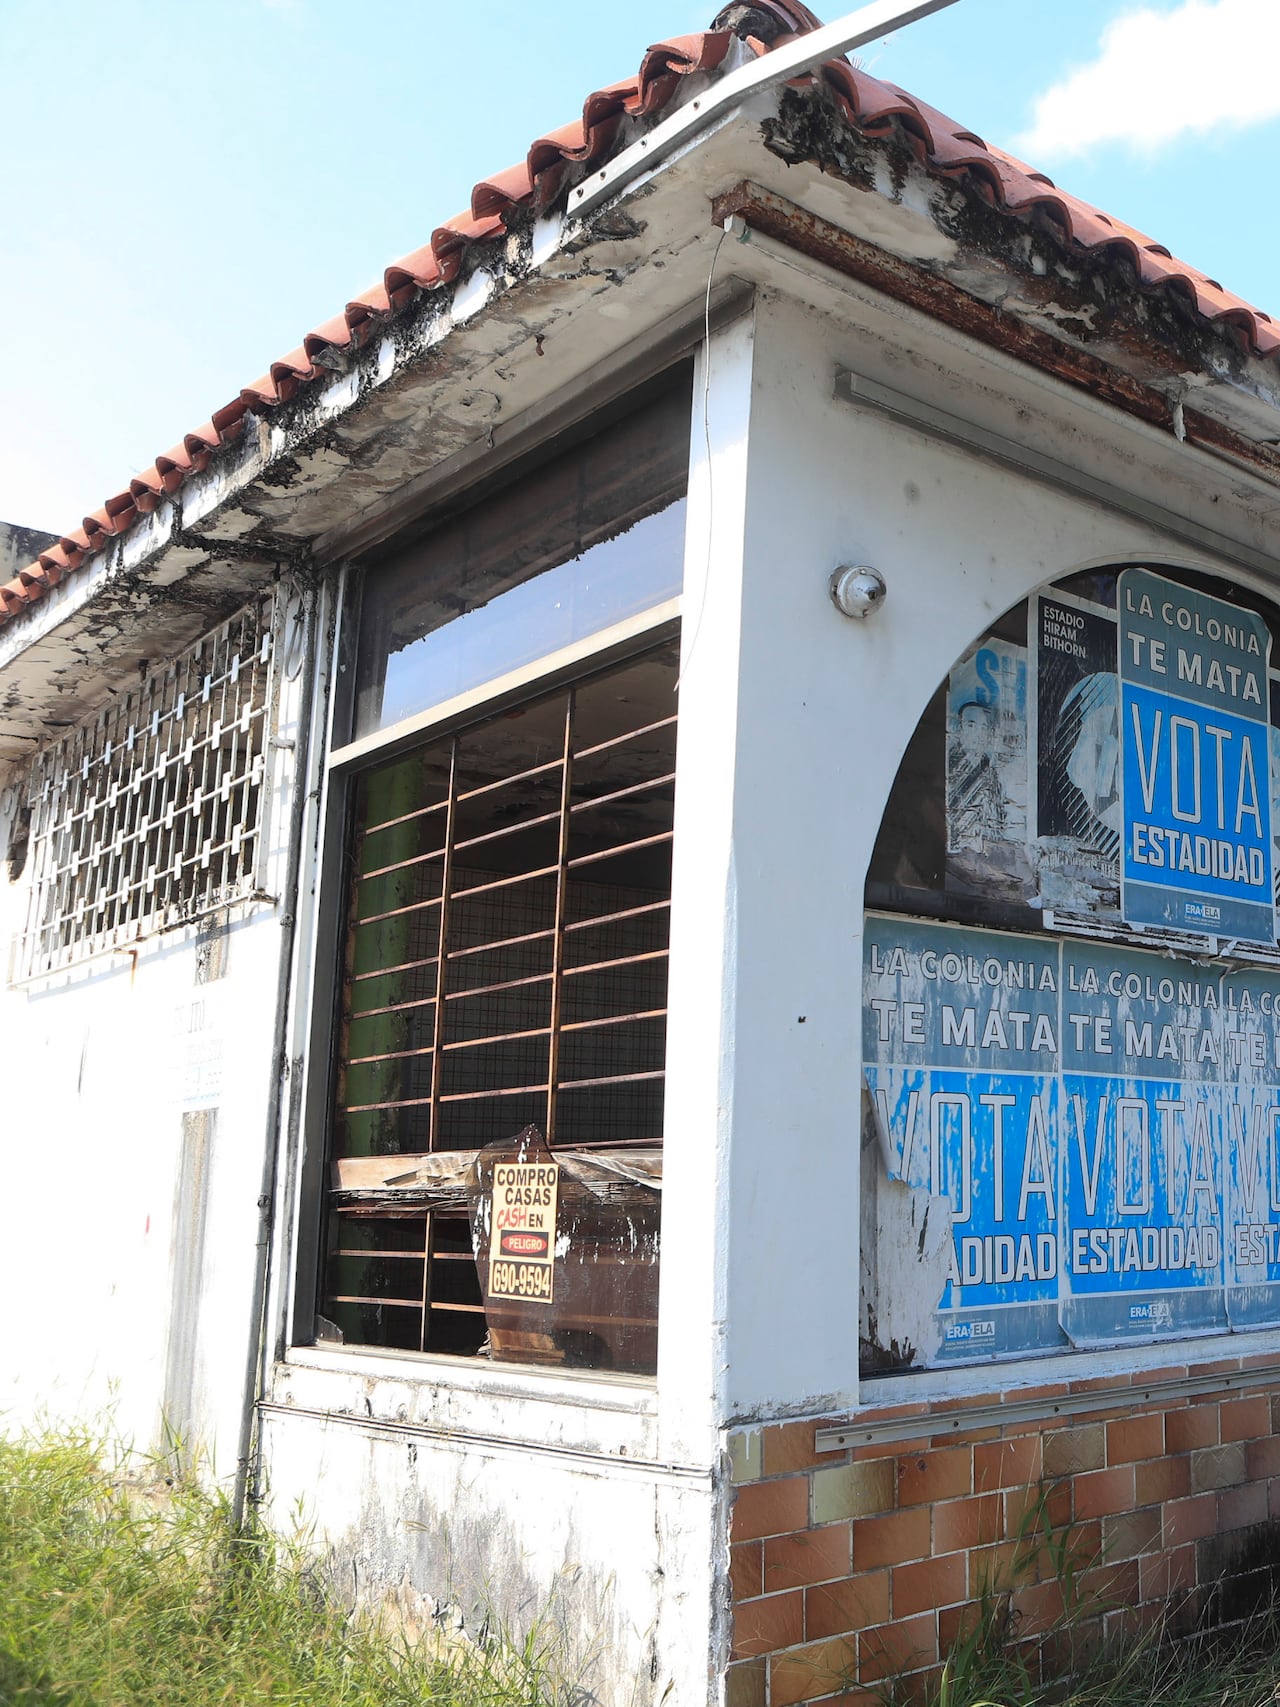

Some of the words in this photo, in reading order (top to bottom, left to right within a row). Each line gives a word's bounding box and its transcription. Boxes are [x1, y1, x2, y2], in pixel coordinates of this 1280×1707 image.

[1043, 605, 1085, 630] ESTADIO
[1043, 620, 1078, 642] HIRAM
[1126, 588, 1154, 619] LA
[1161, 602, 1261, 657] COLONIA
[1043, 633, 1086, 659] BITHORN
[1127, 630, 1168, 675] TE
[1177, 647, 1263, 706] MATA
[1131, 702, 1264, 840] VOTA
[1131, 820, 1266, 887] ESTADIDAD
[871, 944, 910, 977] LA
[920, 951, 1056, 993] COLONIA
[1068, 965, 1100, 994] LA
[1108, 971, 1218, 1010] COLONIA
[1228, 987, 1254, 1013] LA
[871, 999, 926, 1045] TE
[941, 1005, 1057, 1053] MATA
[1068, 1013, 1113, 1054] TE
[1124, 1020, 1219, 1065] MATA
[1229, 1031, 1266, 1068] TE
[875, 1089, 1056, 1224] VOTA
[1072, 1094, 1220, 1217] VOTA
[497, 1167, 557, 1187] COMPRO
[505, 1187, 551, 1206] CASAS
[496, 1207, 528, 1230] CASH
[528, 1213, 544, 1228] EN
[508, 1237, 543, 1251] PELIGRO
[1072, 1226, 1220, 1275] ESTADIDAD
[493, 1262, 551, 1297] 690-9594
[946, 1325, 969, 1339] ERA
[973, 1322, 995, 1337] ELA
[1130, 1306, 1148, 1318] ERA
